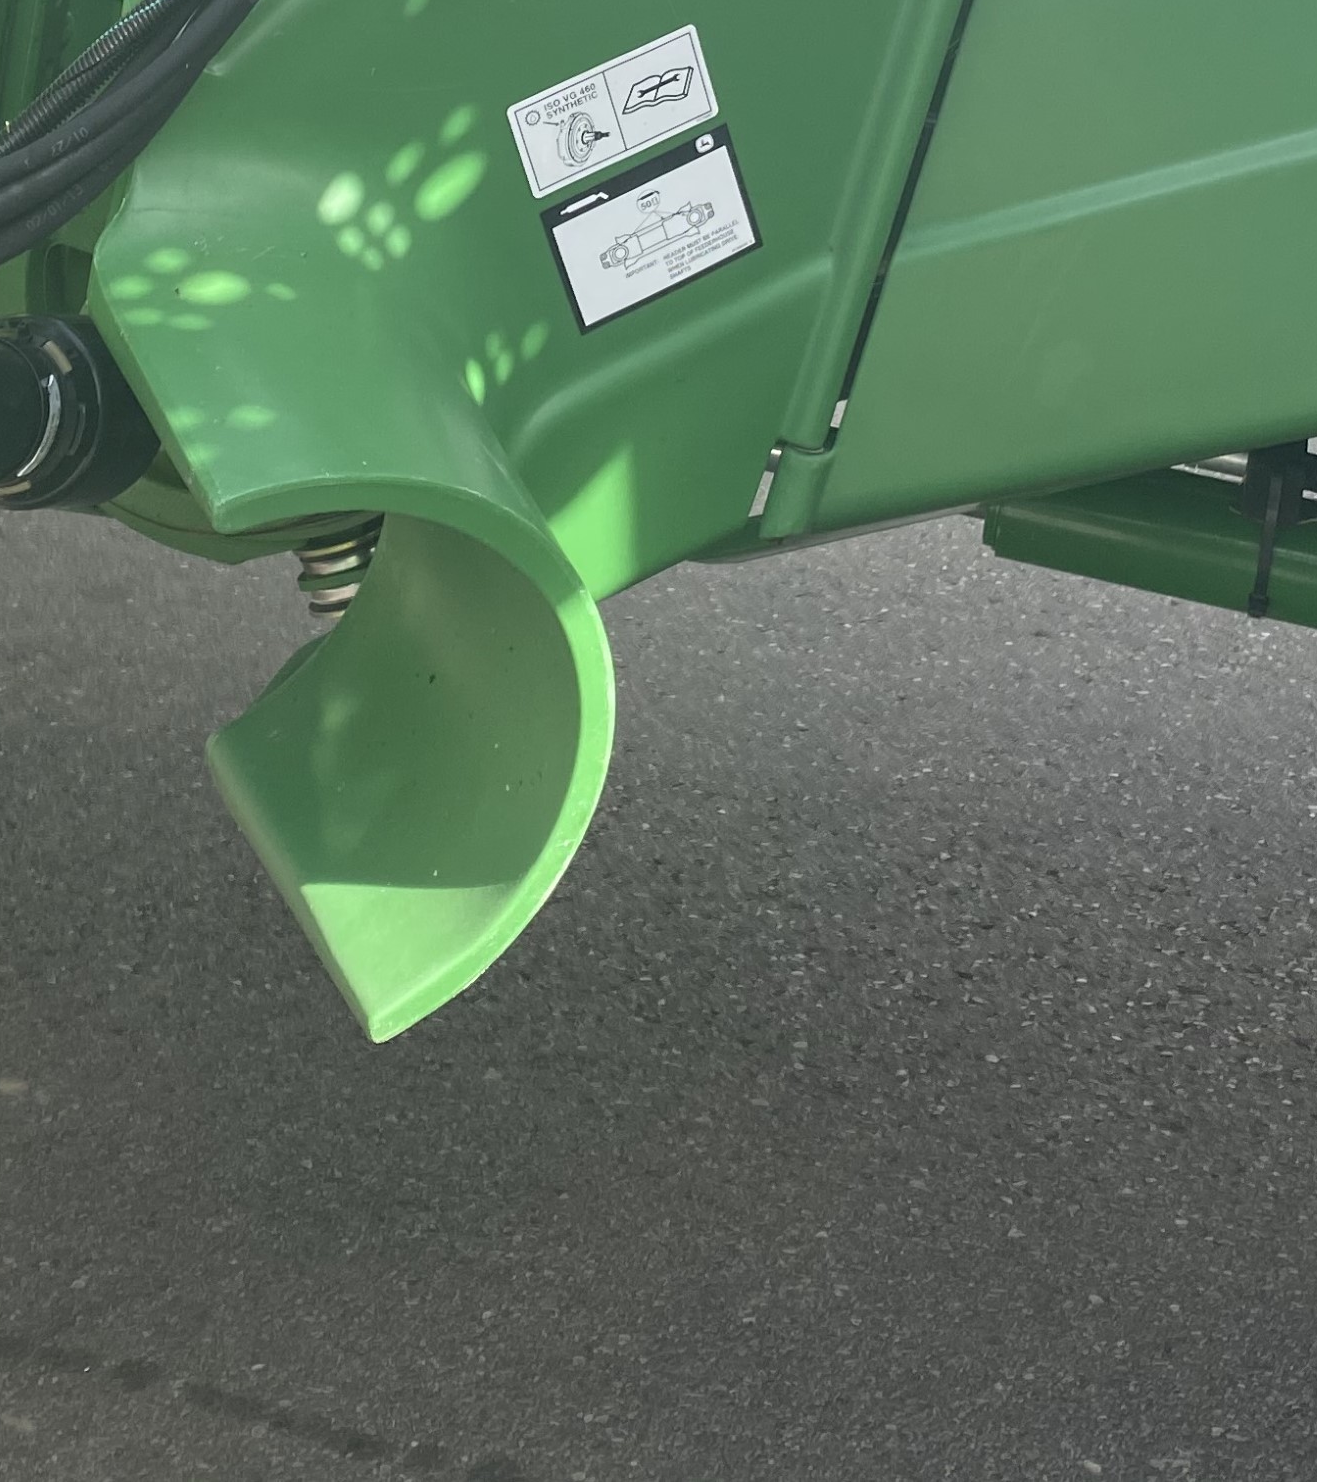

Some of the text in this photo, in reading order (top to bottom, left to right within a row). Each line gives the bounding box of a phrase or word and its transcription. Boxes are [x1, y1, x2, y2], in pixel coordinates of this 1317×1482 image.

[543, 82, 595, 111] ISO VG 460
[546, 90, 598, 120] SYNTHETIC
[663, 246, 686, 260] HEADER
[686, 238, 701, 248] MUST
[711, 220, 739, 236] PARALLEL
[668, 262, 684, 273] WHEN
[685, 243, 721, 264] LUBRICATING
[721, 235, 737, 246] DRIVE
[693, 229, 736, 251] FEEDERHOUSE
[670, 266, 691, 279] SHAFTS
